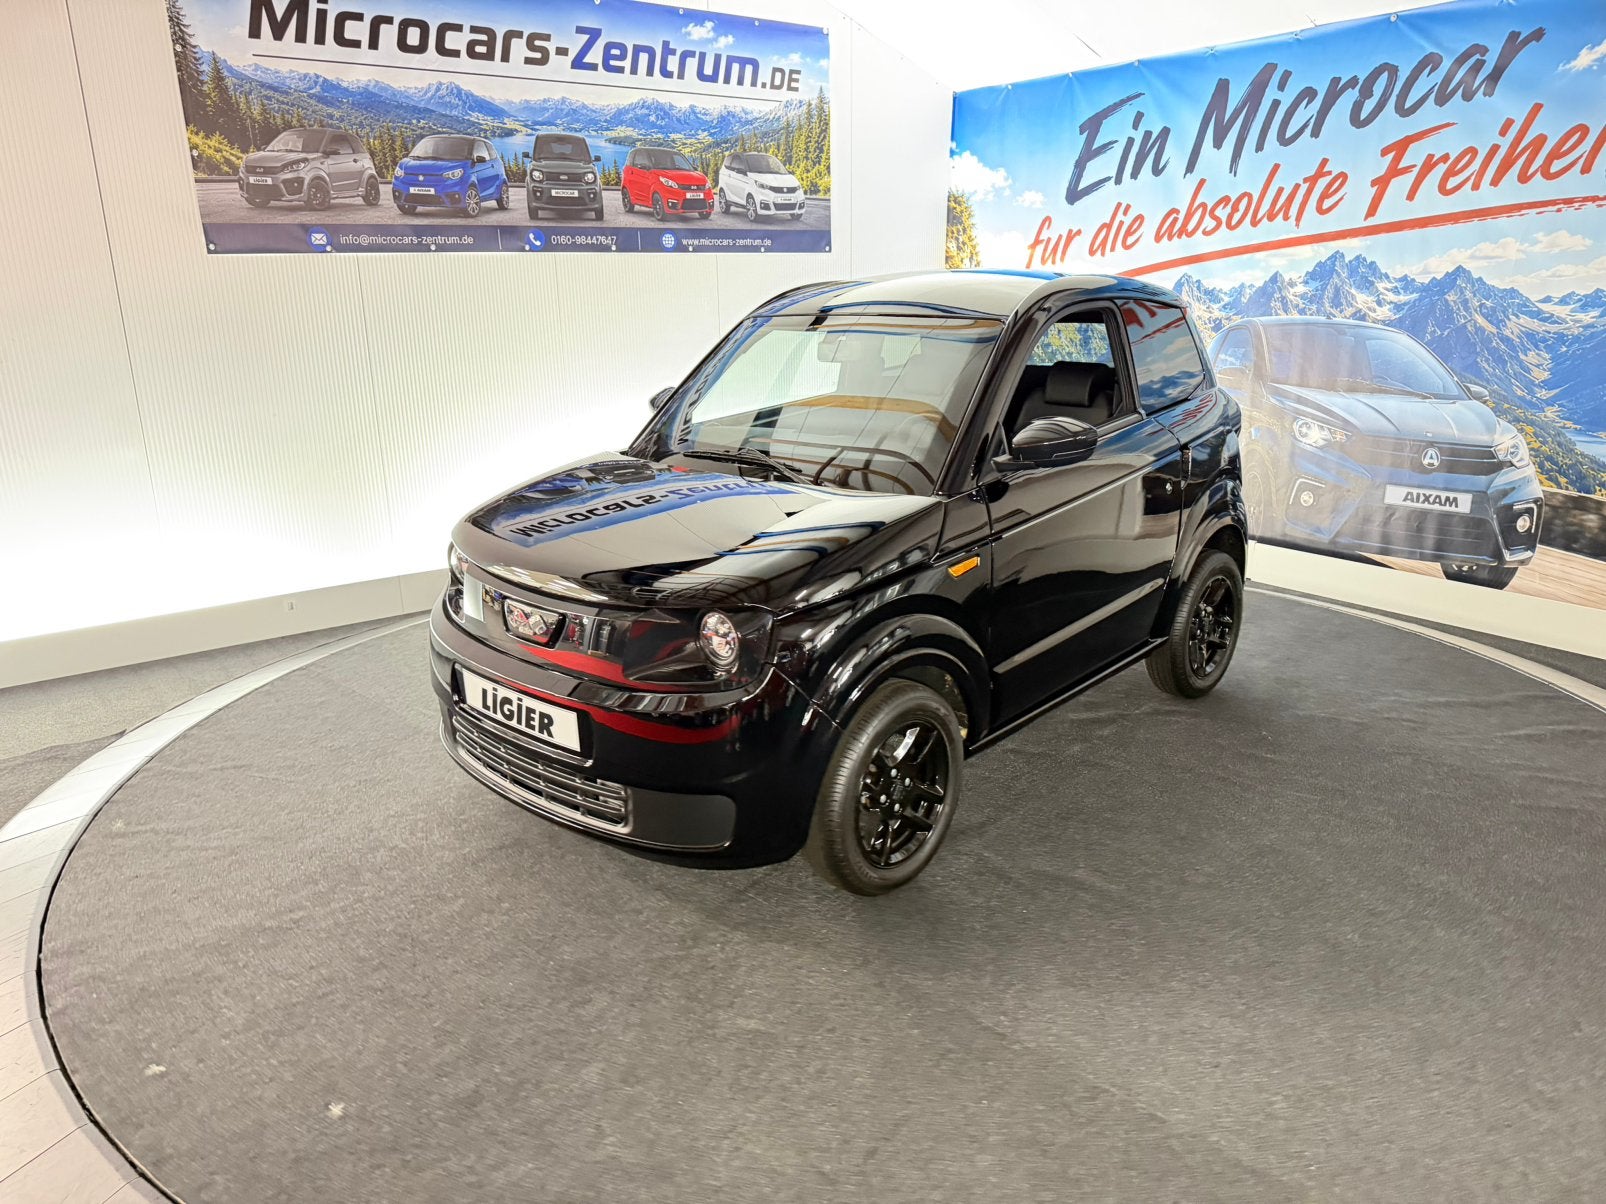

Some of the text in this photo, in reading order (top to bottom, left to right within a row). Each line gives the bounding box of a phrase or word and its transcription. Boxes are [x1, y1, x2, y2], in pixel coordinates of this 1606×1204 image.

[248, 0, 801, 92] Microcars-Zentrum.DE
[1065, 27, 1546, 206] Ein Microcar
[1088, 202, 1145, 257] die
[1154, 157, 1351, 243] absolute
[340, 234, 474, 245] info@microcars-zentrum.de
[551, 235, 617, 245] 0160-98447647
[681, 237, 772, 246] www.microcars-zentrum.de
[1402, 491, 1459, 509] AIXAM
